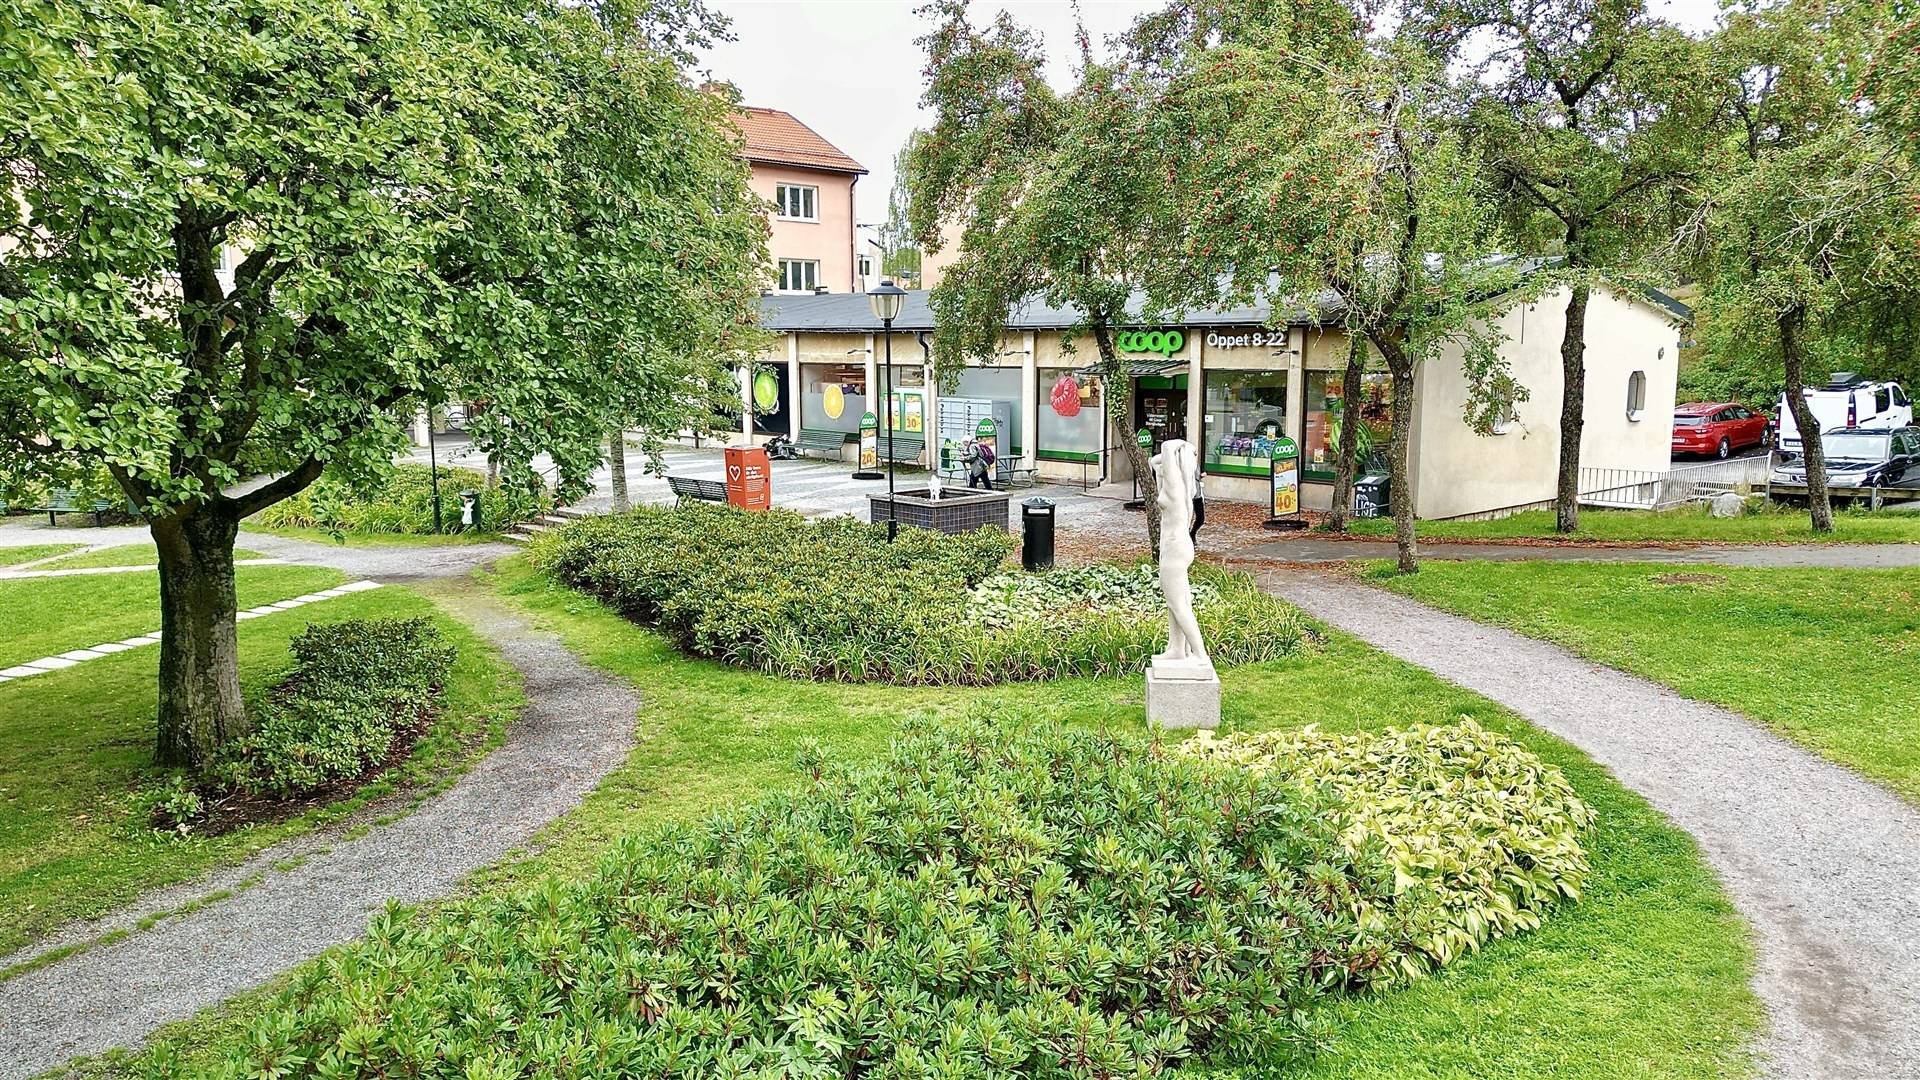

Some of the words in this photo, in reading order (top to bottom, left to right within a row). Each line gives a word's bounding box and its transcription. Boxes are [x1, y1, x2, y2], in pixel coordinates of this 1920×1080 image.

[1118, 331, 1183, 357] coop
[1206, 330, 1248, 349] Öppet
[1252, 332, 1286, 346] 8-22
[862, 418, 876, 426] coop
[979, 425, 994, 433] coop
[1138, 434, 1152, 443] coop
[1276, 444, 1295, 454] coop
